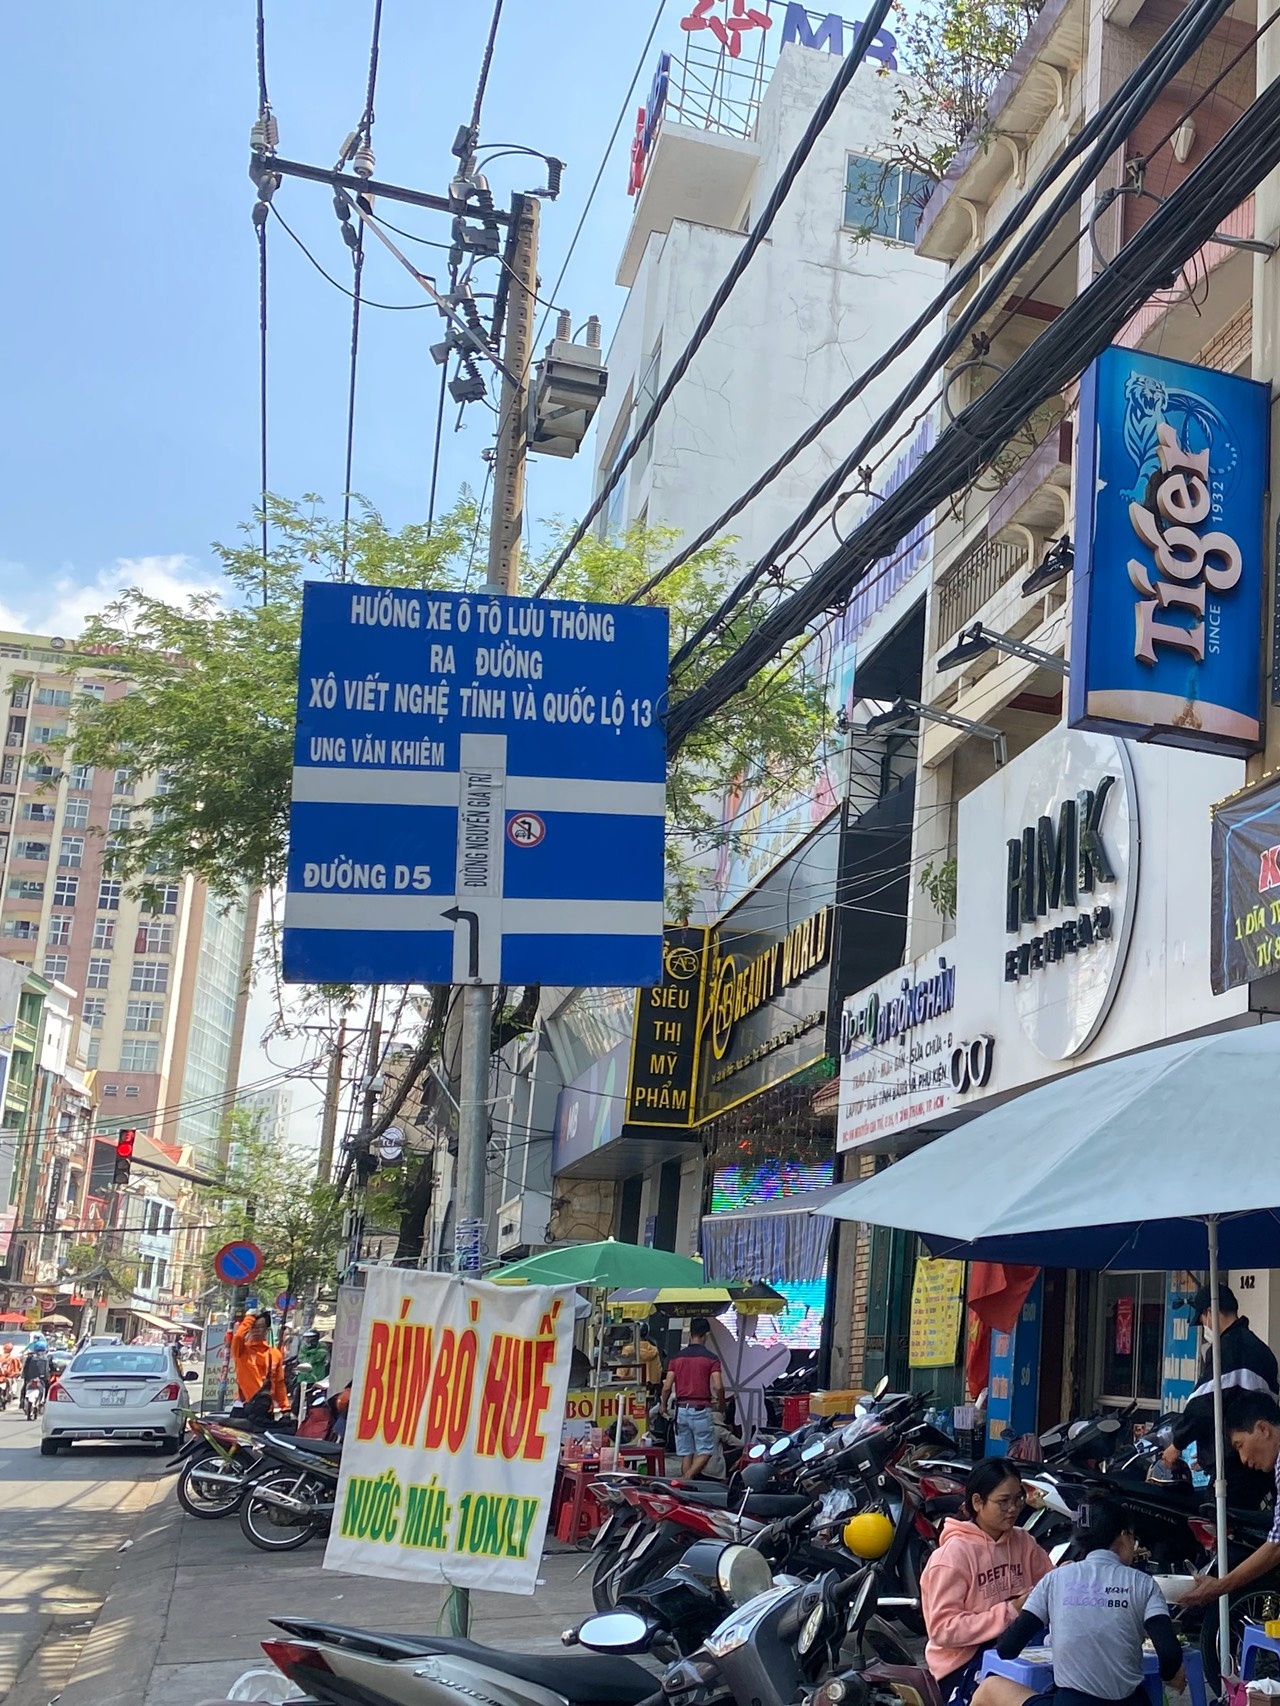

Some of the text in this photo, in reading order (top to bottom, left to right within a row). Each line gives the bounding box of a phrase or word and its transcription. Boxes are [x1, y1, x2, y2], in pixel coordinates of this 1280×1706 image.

[780, 1, 897, 71] MB
[1126, 422, 1242, 667] Tiger
[1208, 480, 1224, 654] SINCE 1932
[350, 588, 615, 642] HƯỚNG XE Ô TÔ LƯU THÔNG
[430, 638, 543, 680] RA ĐƯỜNG
[308, 671, 652, 735] XÔ VIẾT NGHỆ TĨNH VÀ QUỐC LỘ 13
[310, 733, 445, 766] UNG VĂN KHIÊM
[460, 771, 492, 887] ĐƯỜNG NGUYỄN GIA TRÍ
[303, 855, 432, 890] ĐƯỜNG D5
[1005, 775, 1115, 934] HMK
[1234, 917, 1243, 942] 1
[733, 904, 832, 1023] BEAUTY WORLD
[650, 984, 690, 1010] SIÊU
[653, 1020, 682, 1047] THỊ
[649, 1050, 678, 1076] MỸ
[634, 1081, 687, 1110] PHẨM
[1239, 1275, 1255, 1289] 142
[356, 1298, 432, 1447] BÚN
[425, 1299, 481, 1455] BÒ
[475, 1299, 564, 1461] HUẾ
[566, 1395, 594, 1419] BÒ
[340, 1469, 400, 1544] NƯỚC
[1107, 1599, 1129, 1609] BBQ
